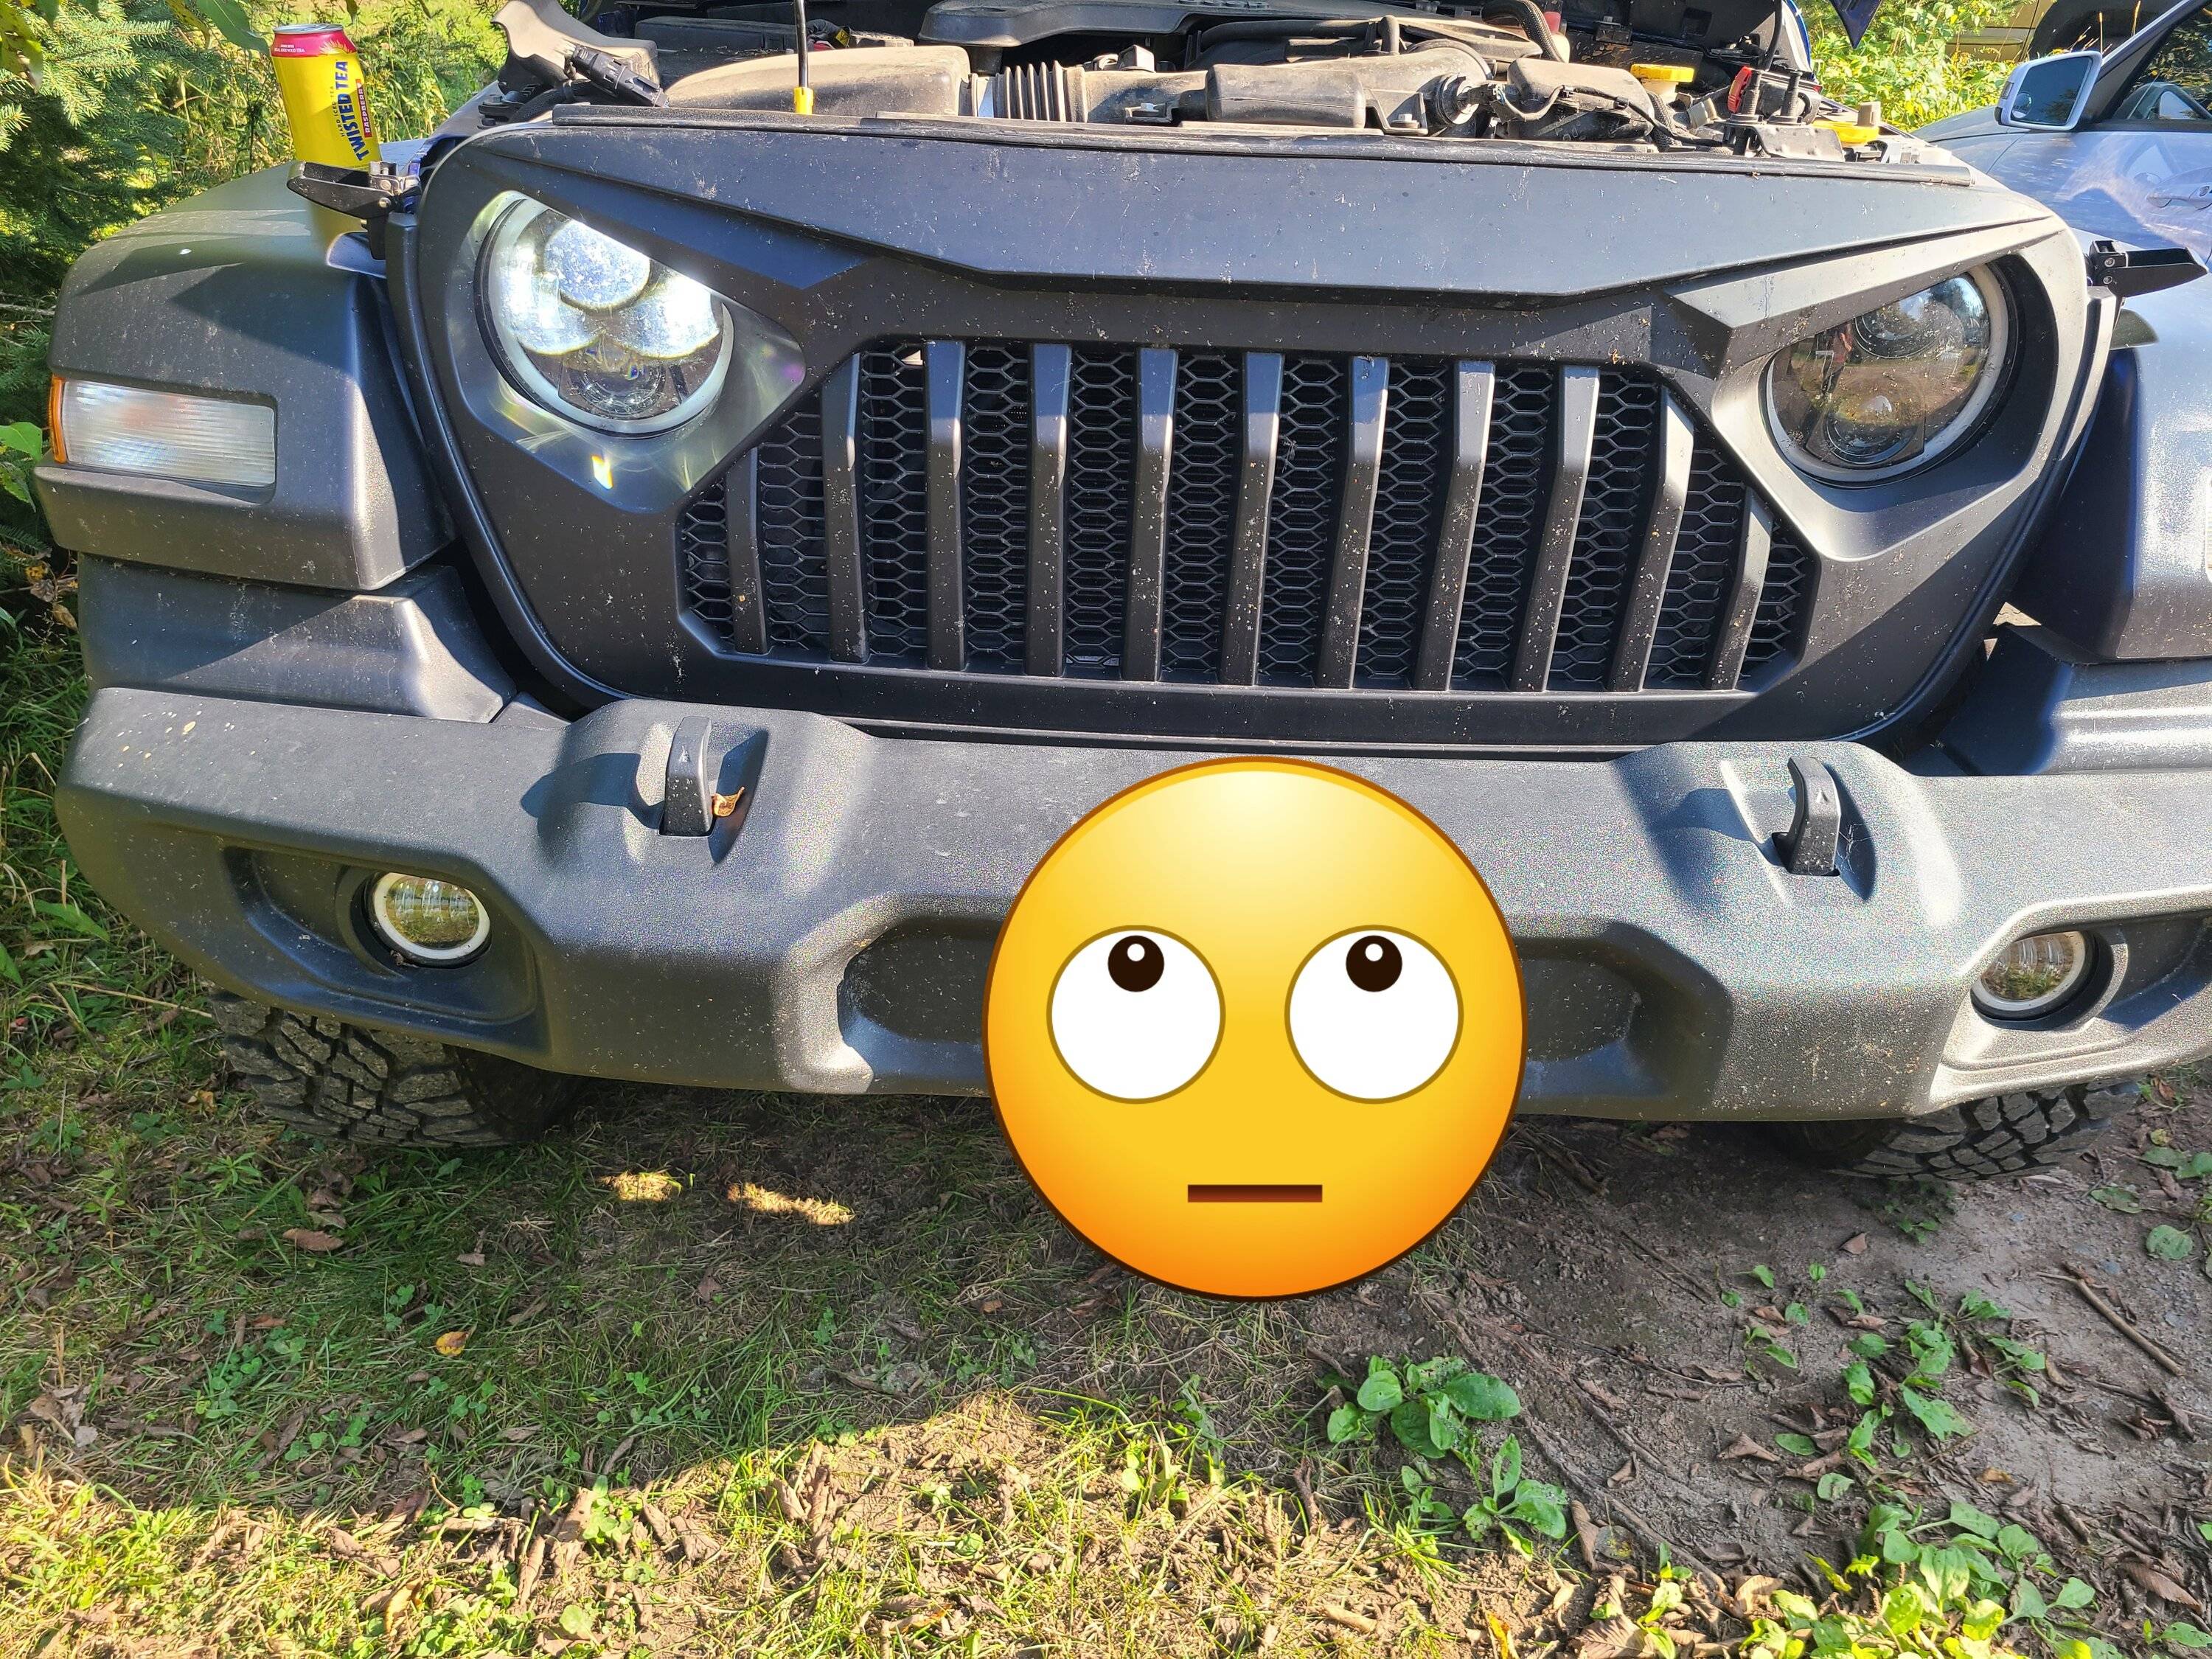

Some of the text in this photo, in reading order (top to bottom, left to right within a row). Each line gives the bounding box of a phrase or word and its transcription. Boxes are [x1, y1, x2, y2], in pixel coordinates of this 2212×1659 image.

[335, 61, 369, 161] TWISTED TEA
[336, 119, 345, 137] HARD
